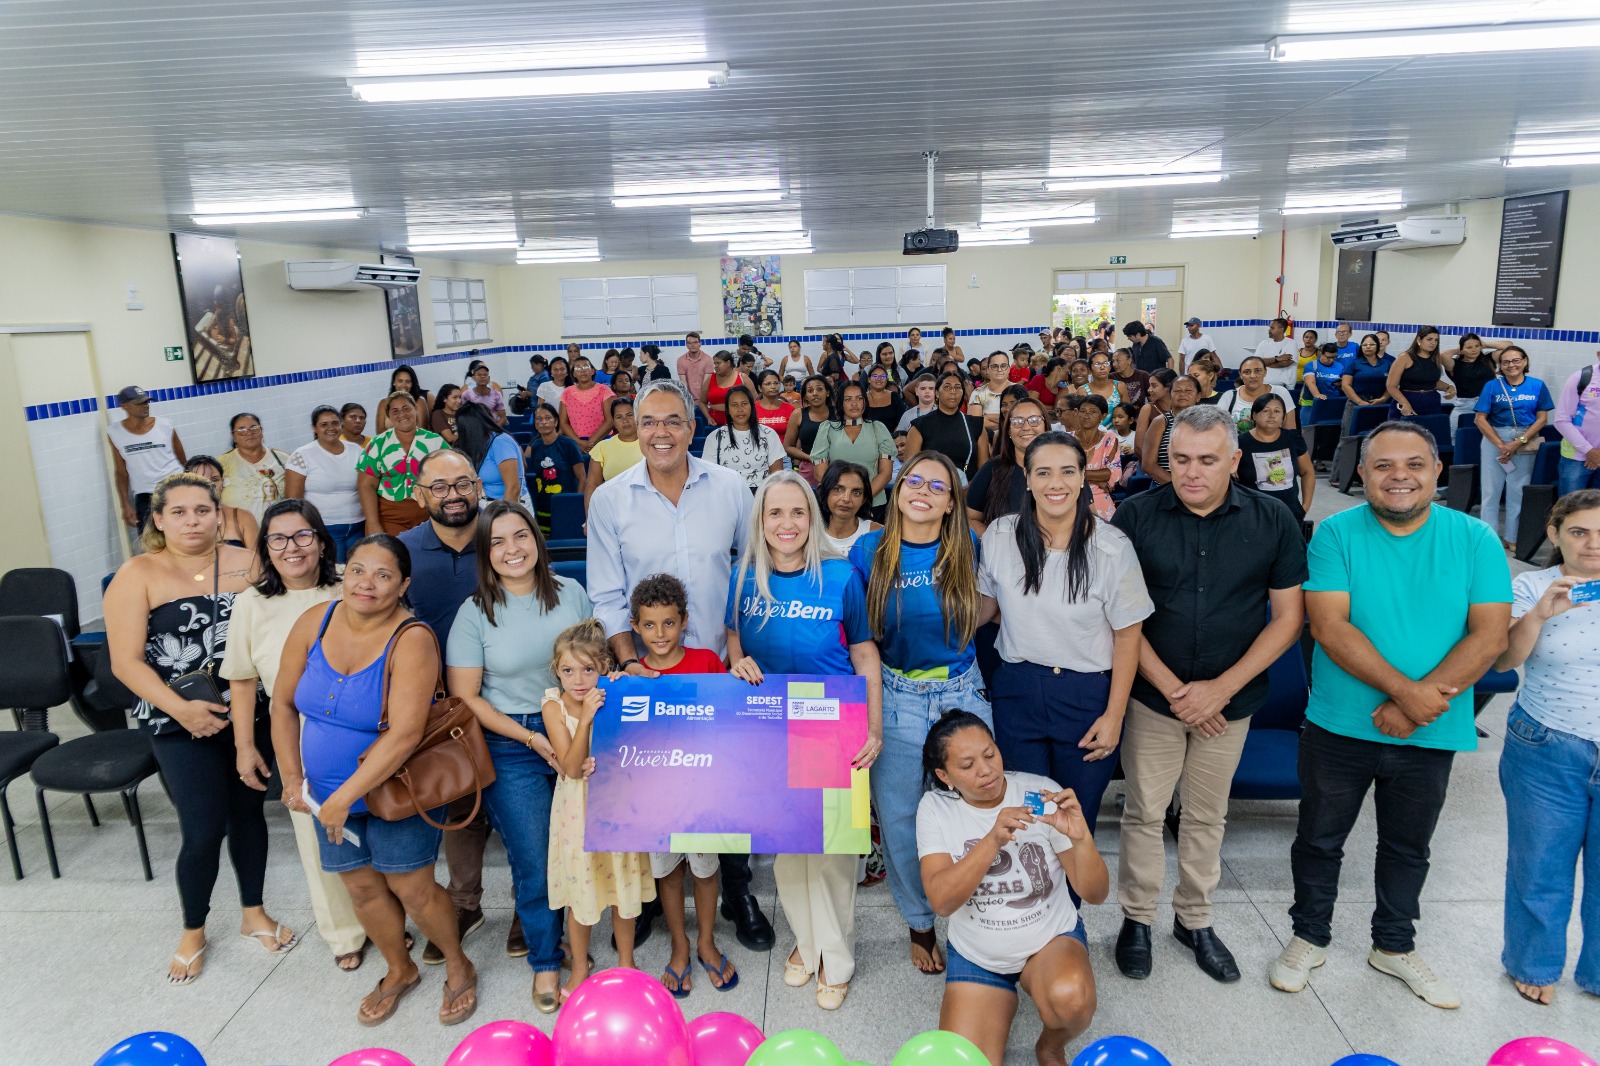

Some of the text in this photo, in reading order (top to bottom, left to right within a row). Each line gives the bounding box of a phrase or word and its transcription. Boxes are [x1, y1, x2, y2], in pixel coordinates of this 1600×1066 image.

[746, 696, 783, 705] SEDEST
[654, 701, 715, 716] Banese
[979, 909, 1043, 927] WESTERN SHOW
